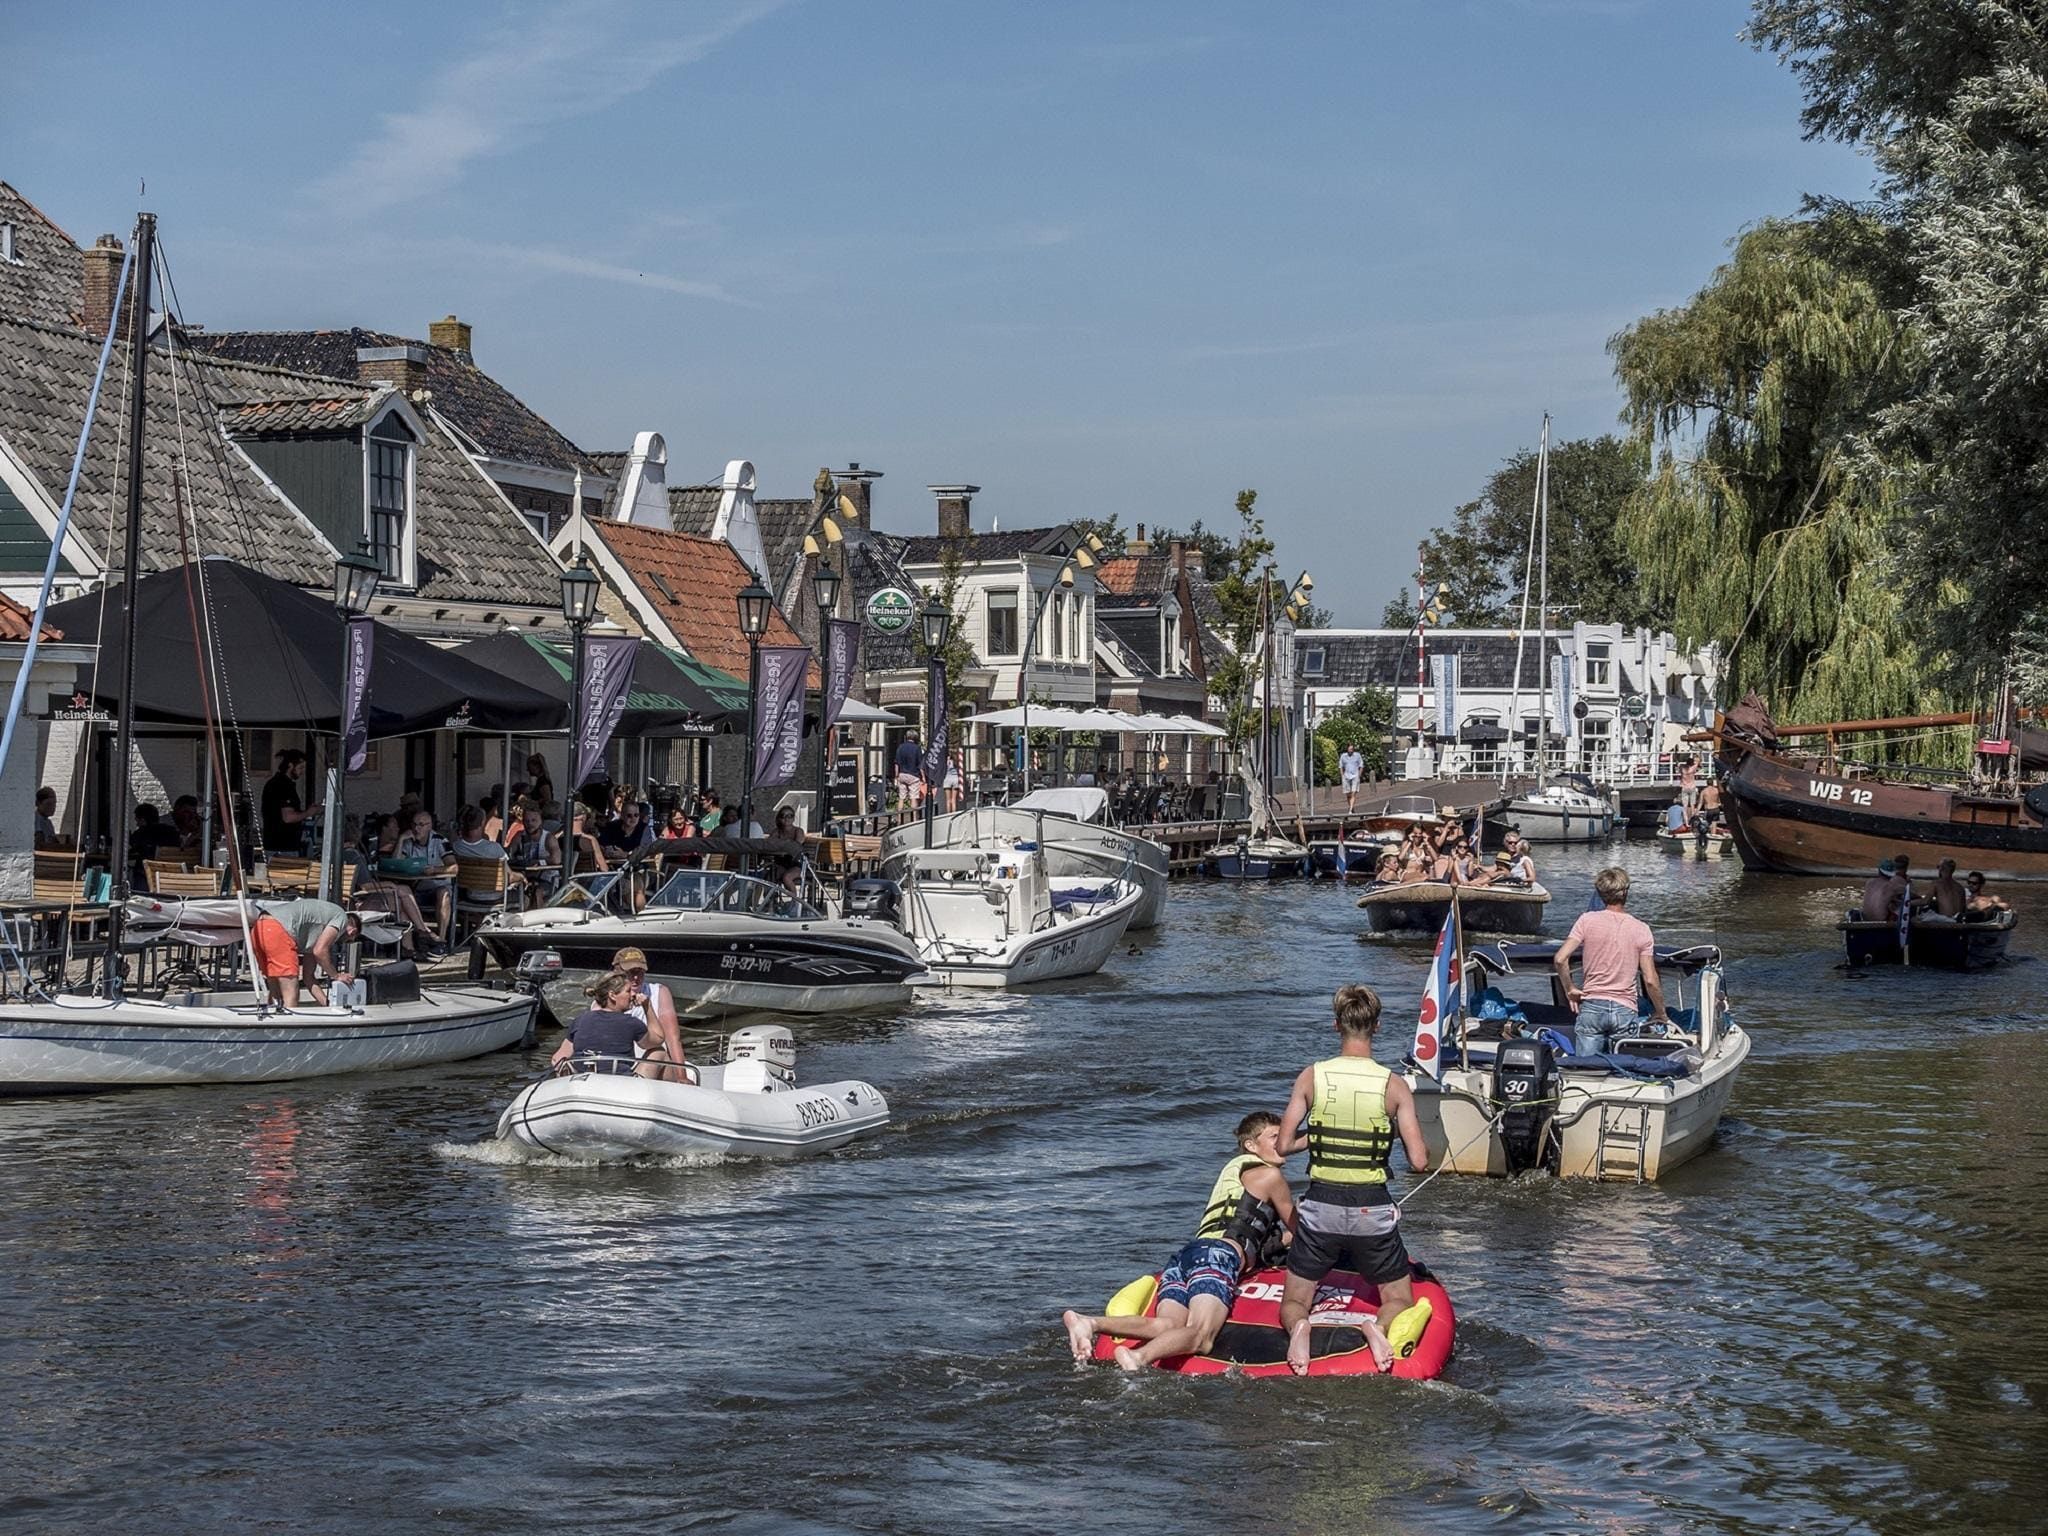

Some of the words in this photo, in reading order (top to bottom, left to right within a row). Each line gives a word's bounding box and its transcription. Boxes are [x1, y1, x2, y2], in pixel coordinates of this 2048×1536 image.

[870, 606, 910, 615] Heineken
[54, 709, 109, 720] Heineken
[1809, 780, 1844, 801] WB
[1850, 789, 1873, 806] 12
[1504, 1079, 1528, 1094] 30
